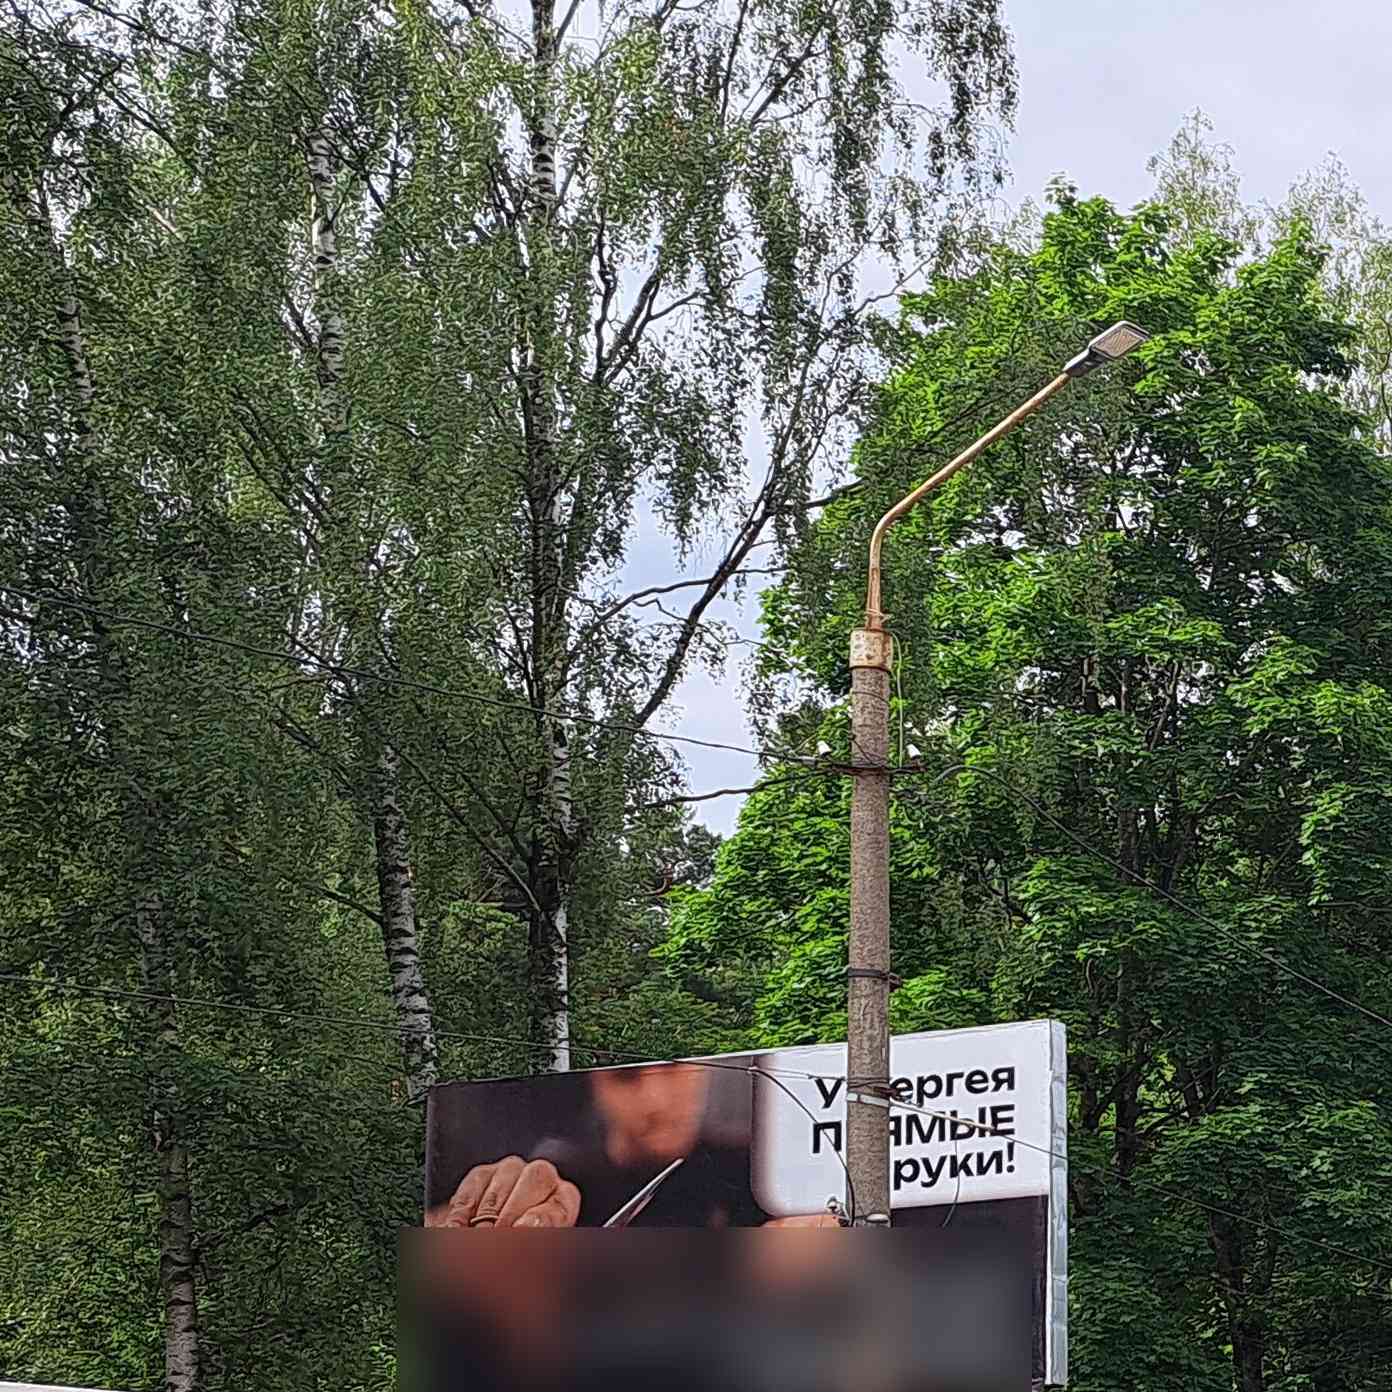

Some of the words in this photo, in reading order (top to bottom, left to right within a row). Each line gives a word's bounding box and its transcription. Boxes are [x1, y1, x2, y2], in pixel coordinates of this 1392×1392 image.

[889, 1065, 1016, 1109] ергея
[812, 1103, 1016, 1154] ПМЫЕ
[893, 1141, 1016, 1191] руки!
